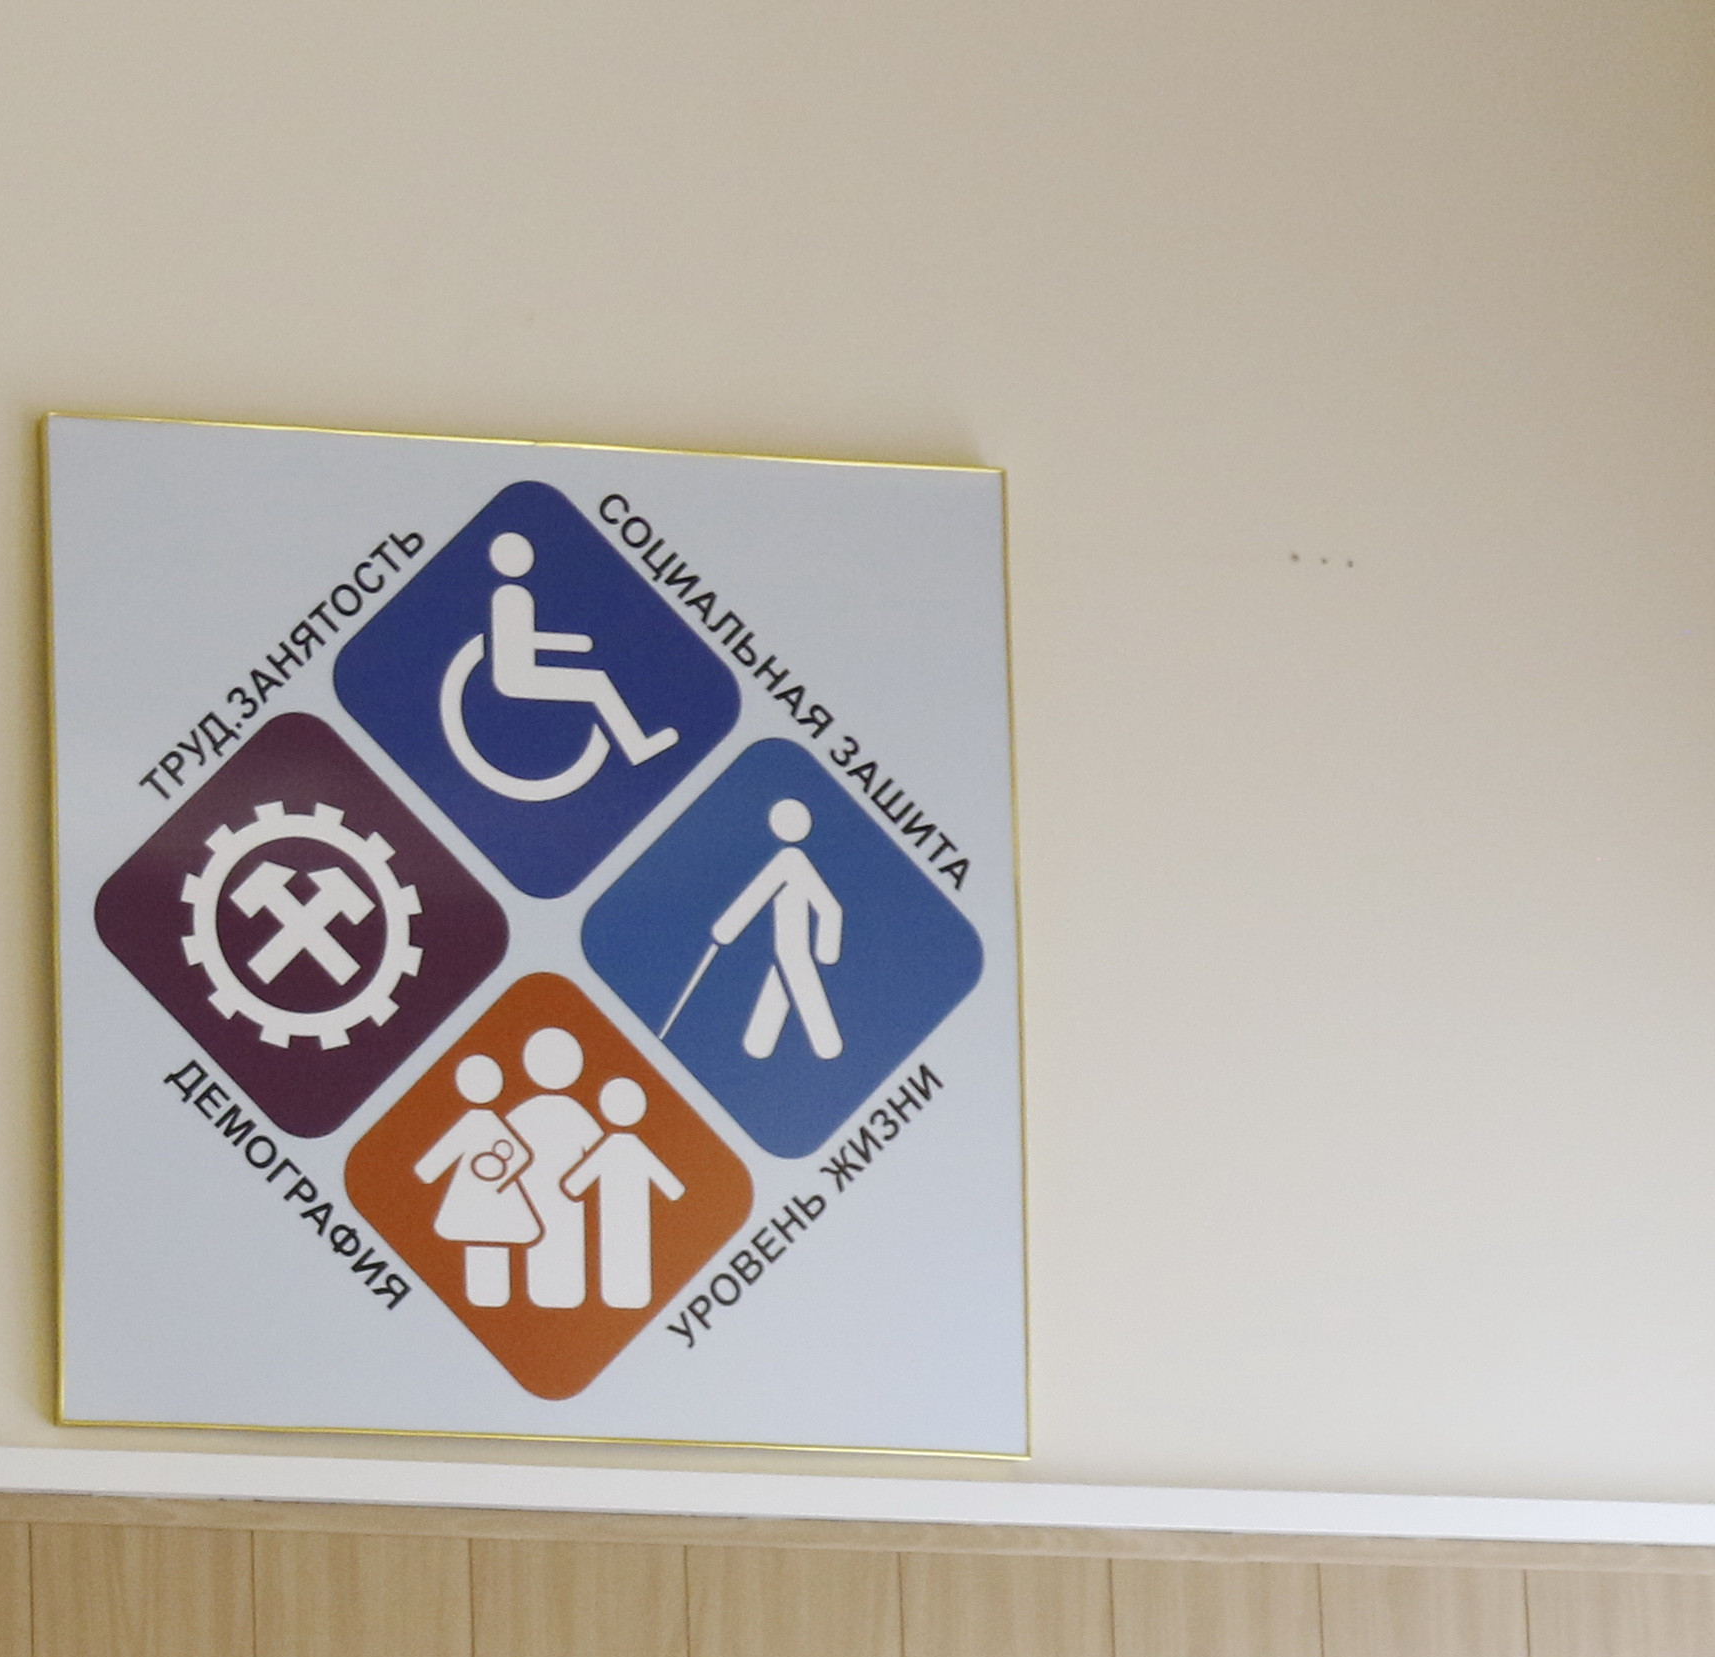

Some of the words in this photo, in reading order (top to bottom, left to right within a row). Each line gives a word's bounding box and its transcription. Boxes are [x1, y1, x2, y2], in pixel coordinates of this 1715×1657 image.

[598, 492, 835, 740] СОЦИАЛЬНАЯ
[163, 1058, 413, 1311] ДЕМОГРАФИЯ
[666, 1193, 827, 1349] УРОВЕНЬ
[819, 1063, 944, 1194] ЖИЗНИ
